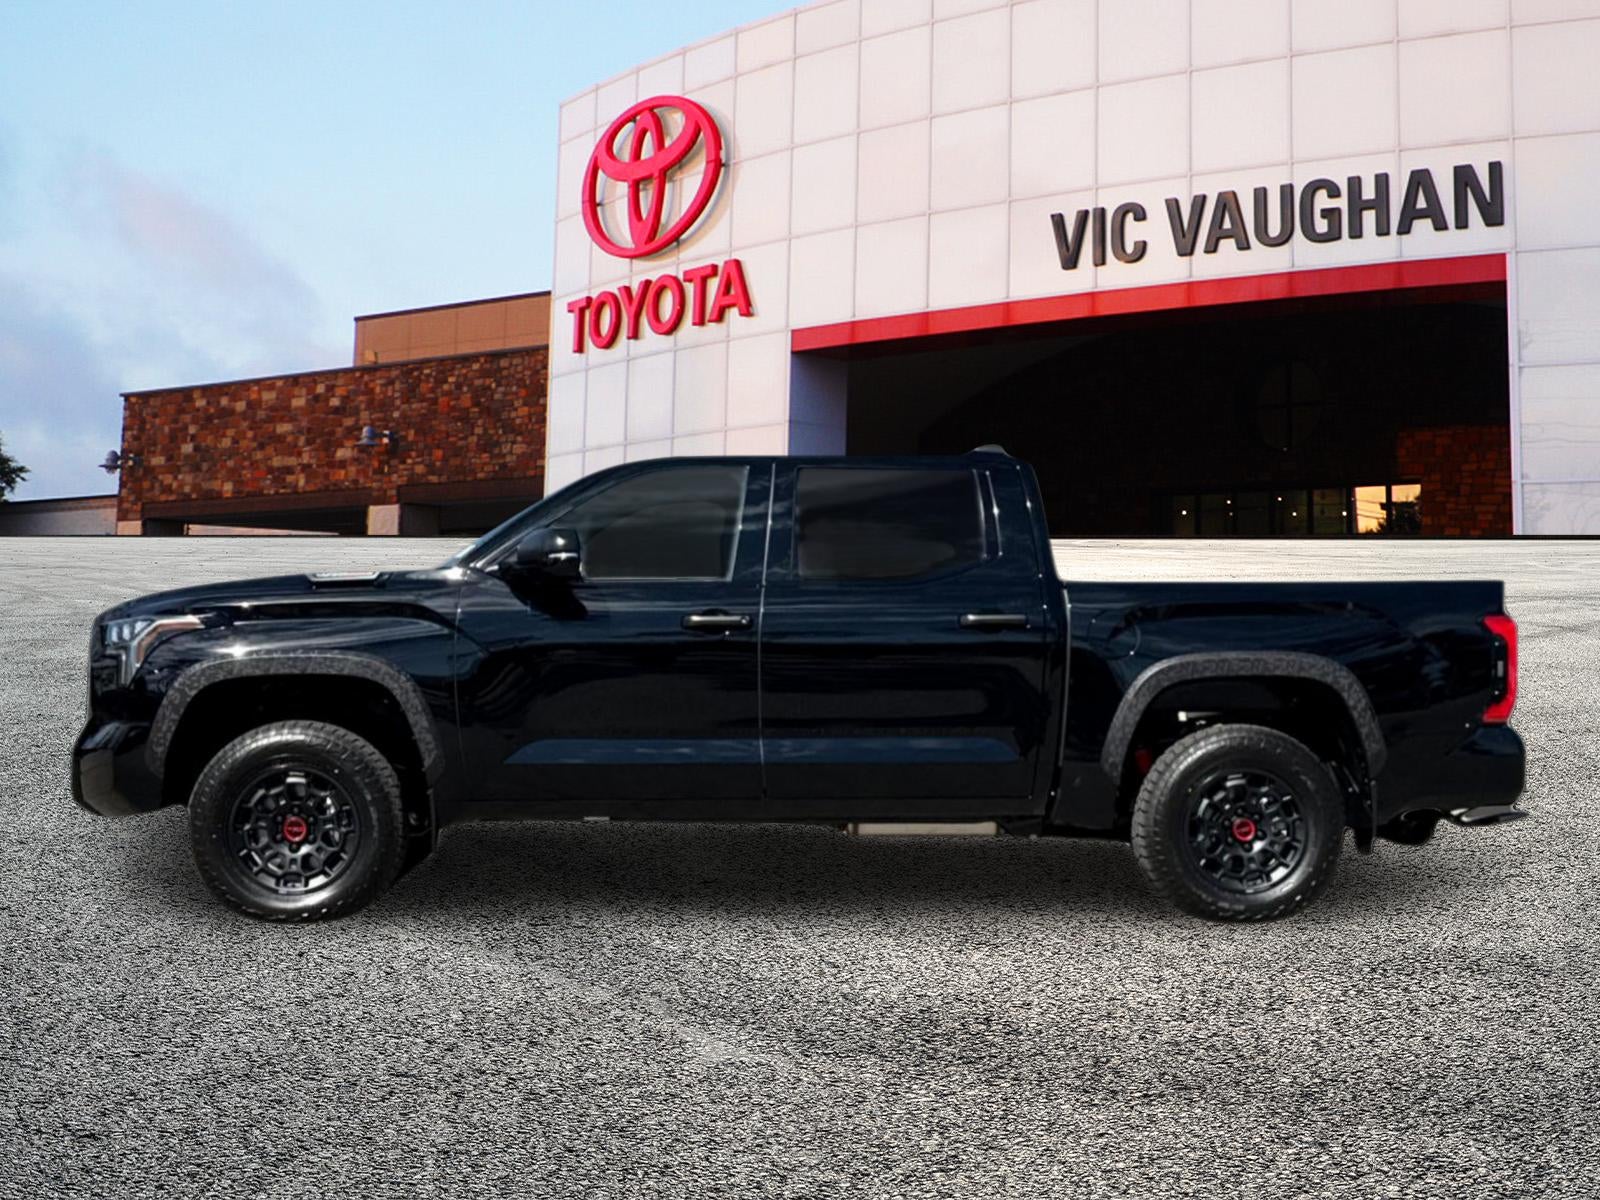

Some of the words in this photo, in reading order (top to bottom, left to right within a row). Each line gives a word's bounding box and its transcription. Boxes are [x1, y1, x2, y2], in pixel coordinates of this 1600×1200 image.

[1051, 203, 1147, 270] VIC
[1165, 161, 1505, 257] VAUGHAN
[568, 259, 753, 353] TOYOTA
